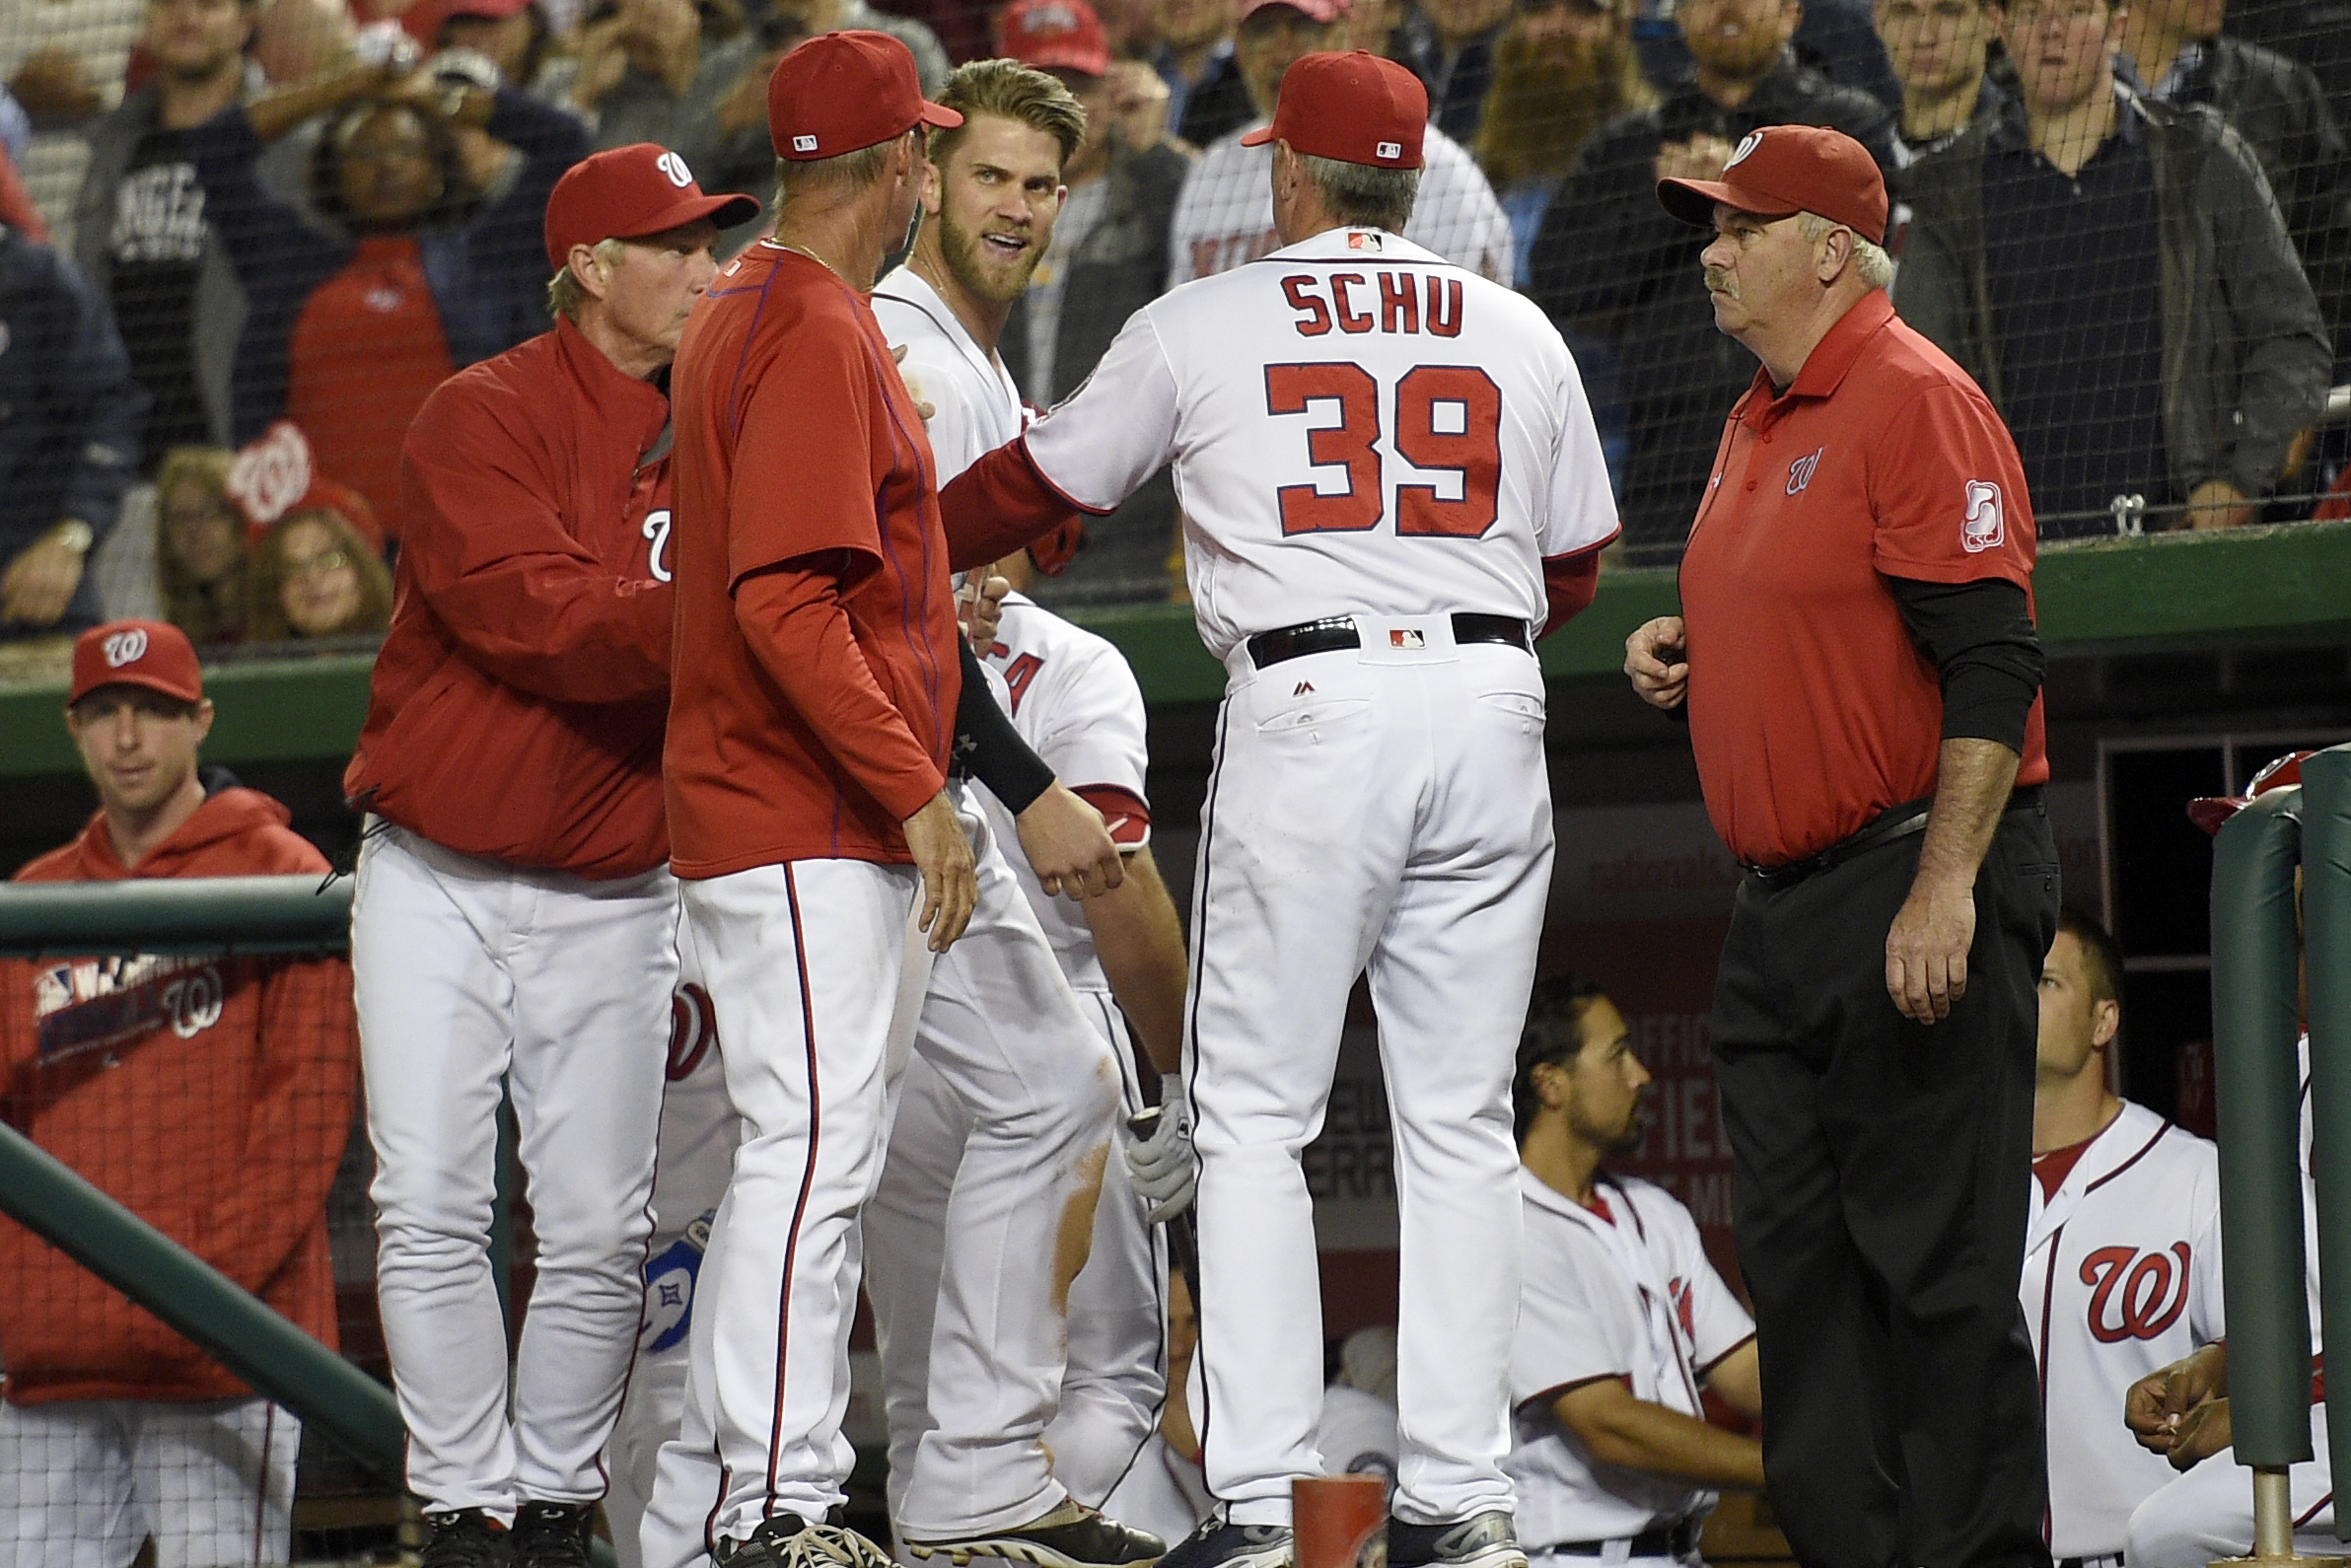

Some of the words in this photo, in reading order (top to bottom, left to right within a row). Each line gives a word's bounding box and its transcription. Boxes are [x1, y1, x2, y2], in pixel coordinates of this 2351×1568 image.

[657, 152, 693, 188] W
[1280, 271, 1462, 338] SCHU
[1263, 361, 1503, 539] 39
[1786, 447, 1823, 496] W
[1966, 534, 1995, 548] CSC
[103, 628, 148, 669] W
[162, 964, 224, 1039] W
[2079, 1240, 2191, 1343] W
